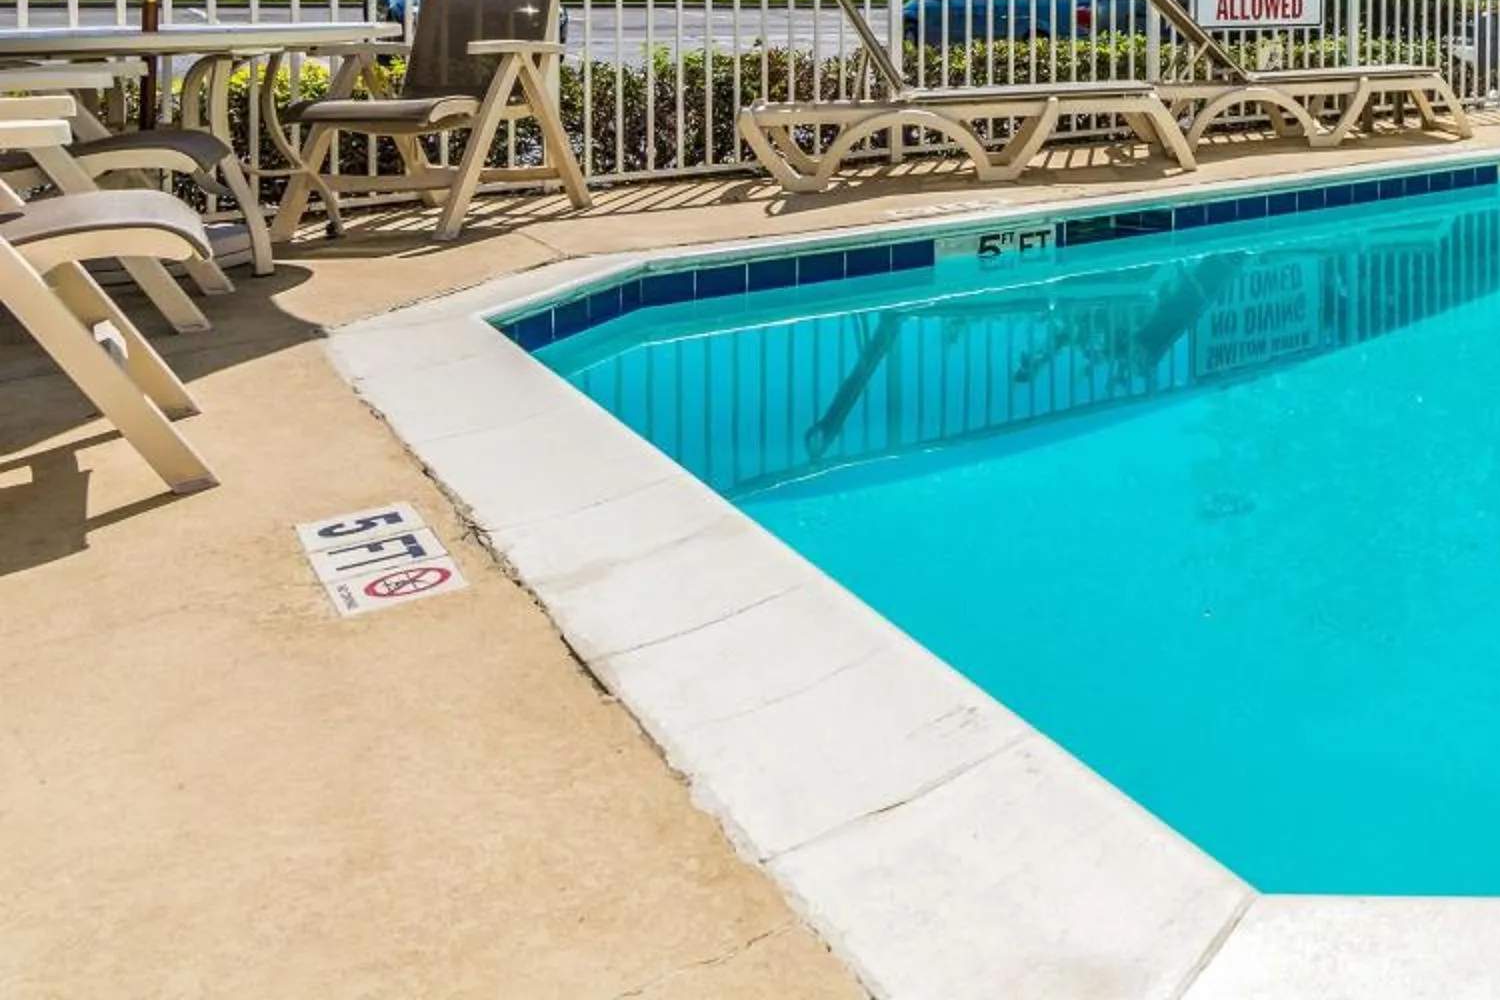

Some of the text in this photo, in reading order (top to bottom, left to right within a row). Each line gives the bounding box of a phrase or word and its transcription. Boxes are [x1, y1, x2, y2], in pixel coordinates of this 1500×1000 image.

[1019, 230, 1051, 253] FT
[317, 511, 427, 571] 5 FT
